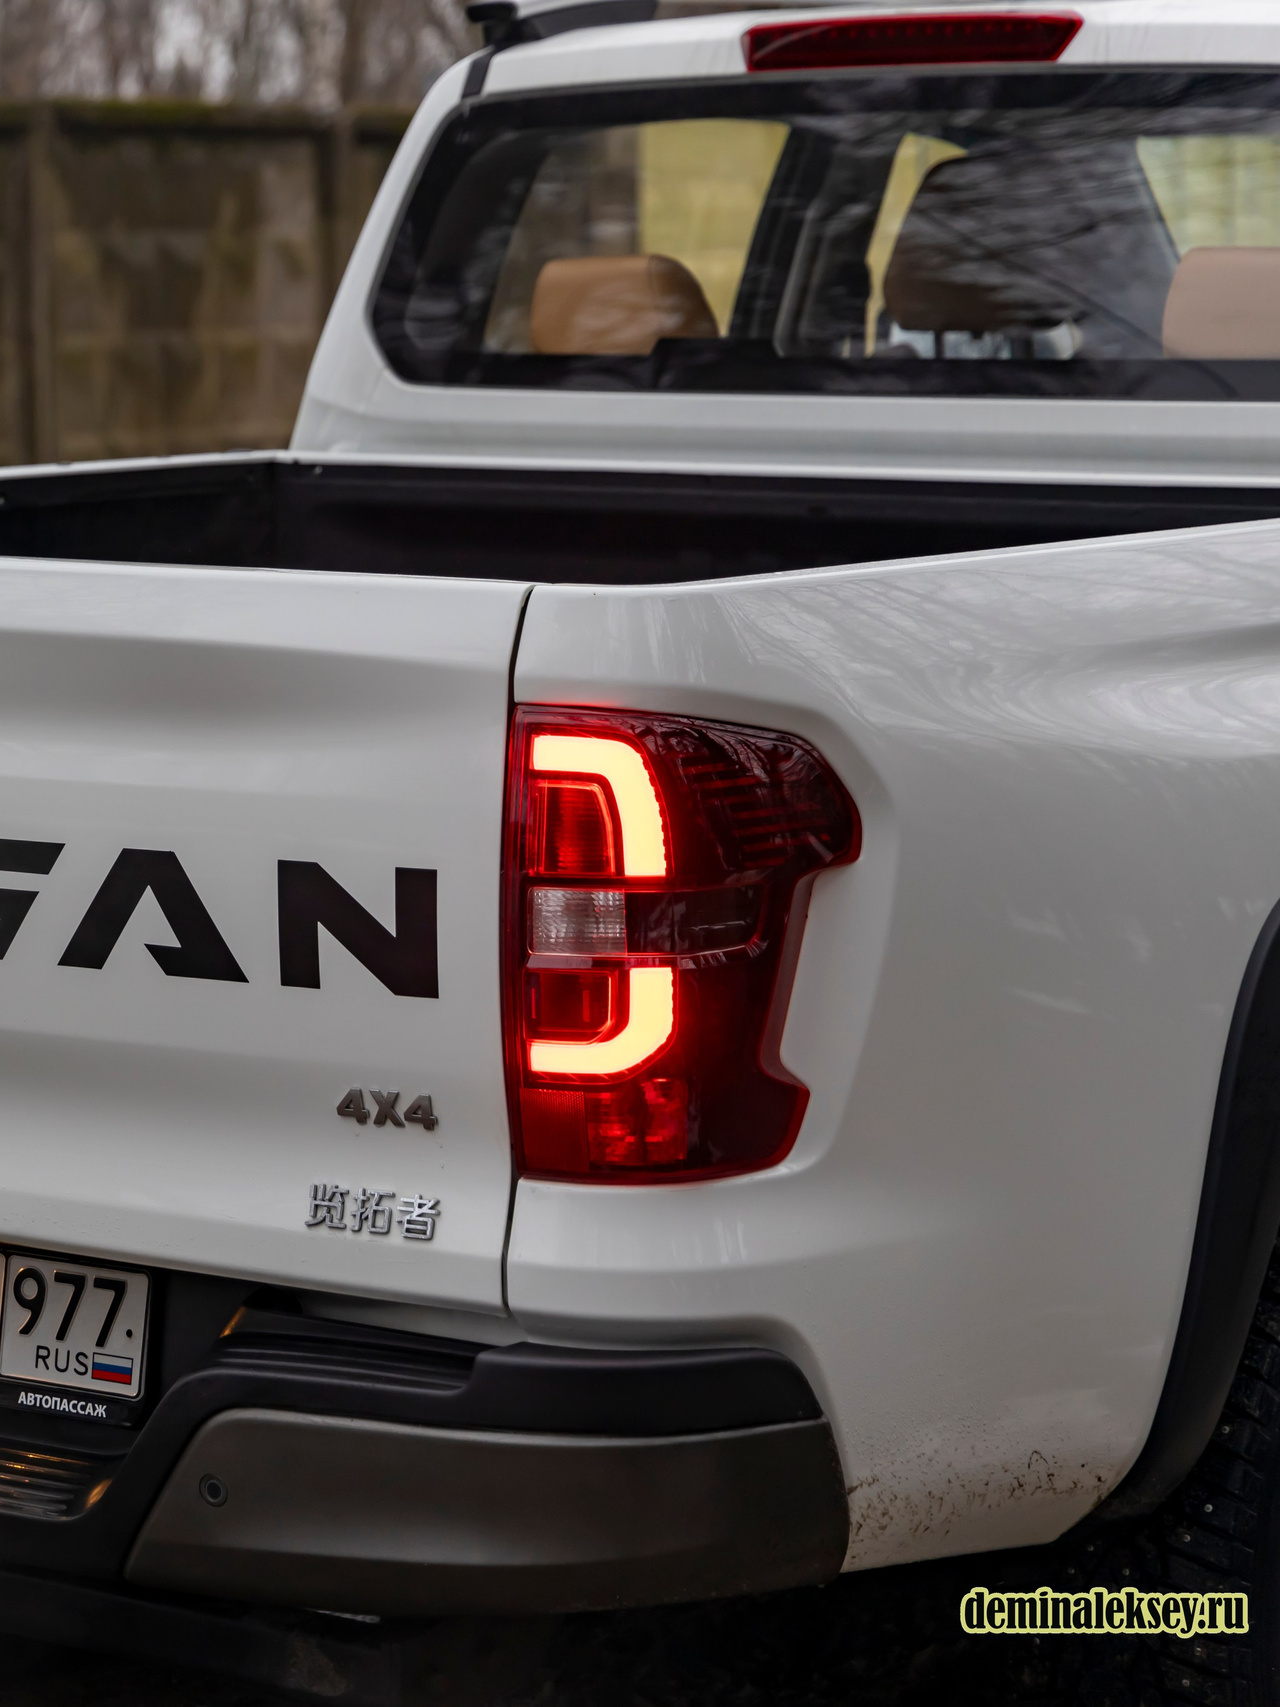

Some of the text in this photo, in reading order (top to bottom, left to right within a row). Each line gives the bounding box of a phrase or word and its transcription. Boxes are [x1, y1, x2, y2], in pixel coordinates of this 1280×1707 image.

[336, 1088, 439, 1131] 4X4
[305, 1183, 441, 1241] 览拓者
[12, 1267, 127, 1348] 977
[34, 1344, 90, 1377] RUS
[18, 1391, 107, 1418] АВТОПАССАЖ
